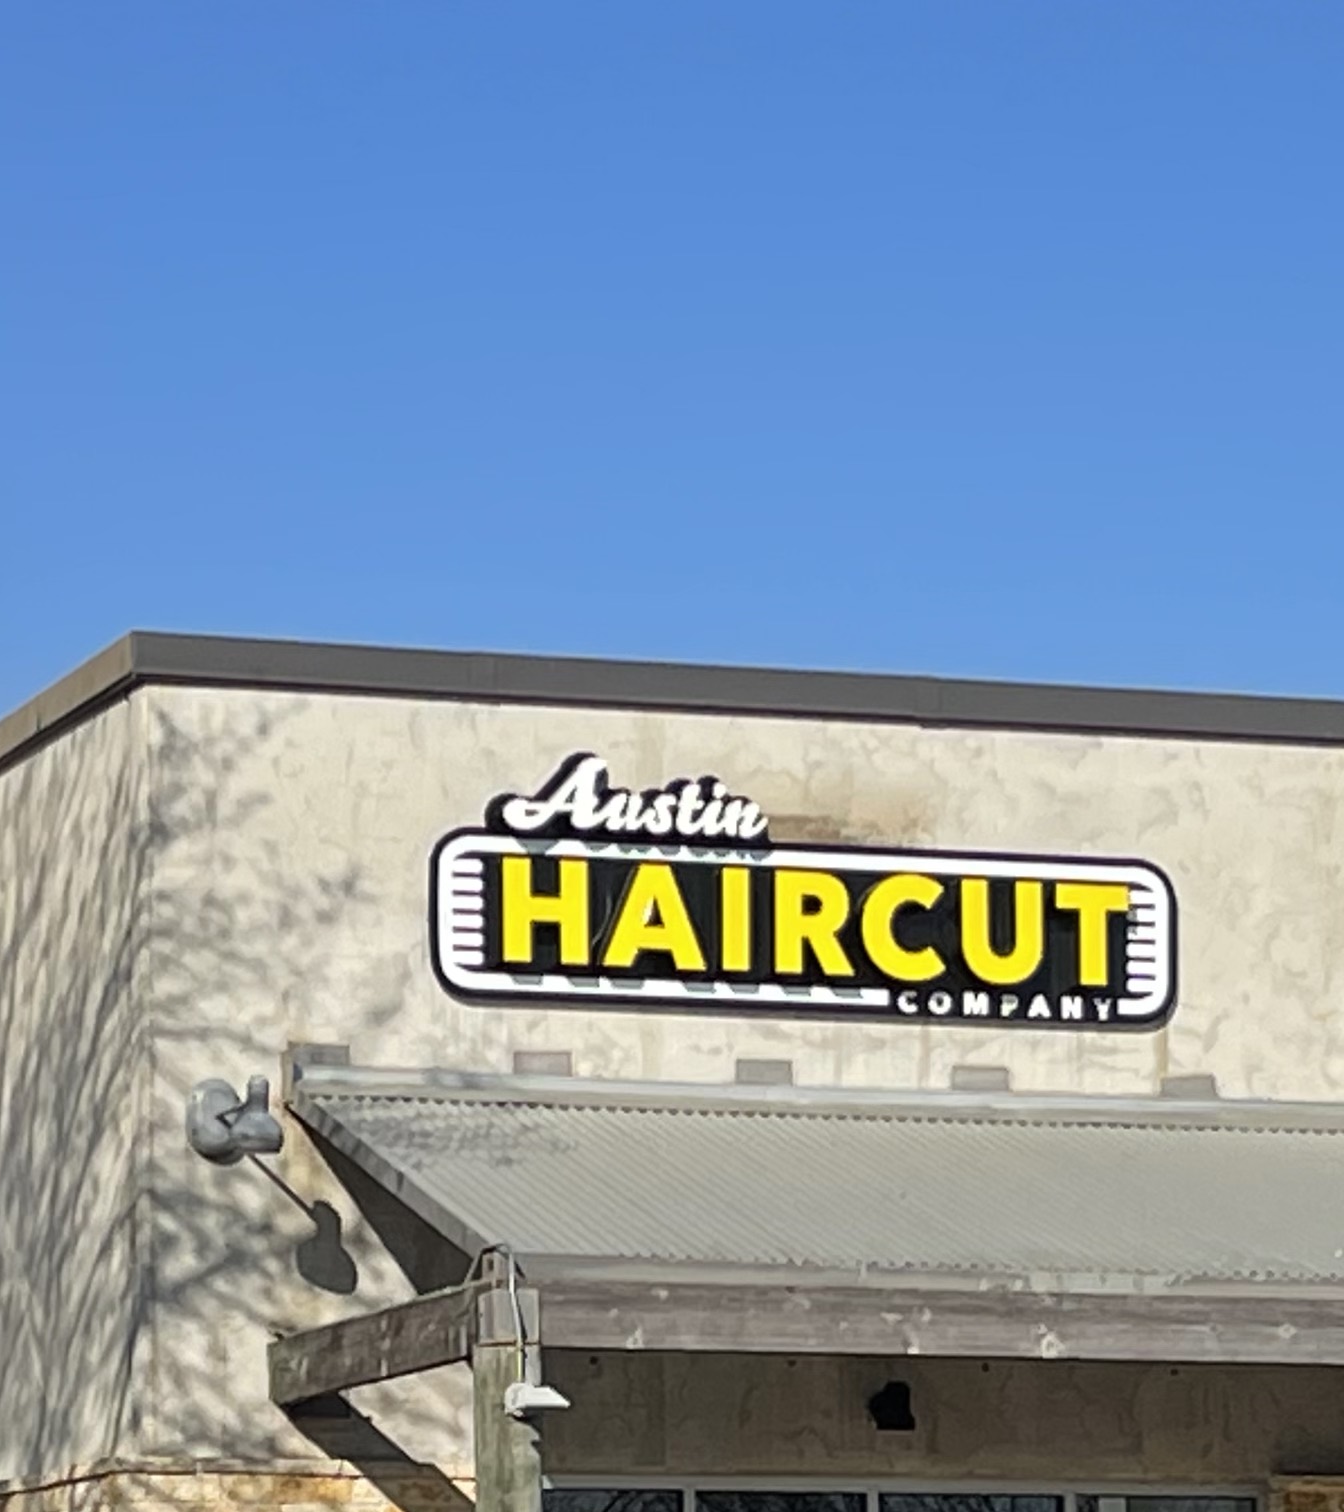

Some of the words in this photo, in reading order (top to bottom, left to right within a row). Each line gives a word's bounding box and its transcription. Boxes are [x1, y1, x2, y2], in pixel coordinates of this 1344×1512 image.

[502, 756, 769, 838] Austin
[499, 854, 1131, 987] HAIRCUT
[896, 990, 1112, 1022] COMPANY
